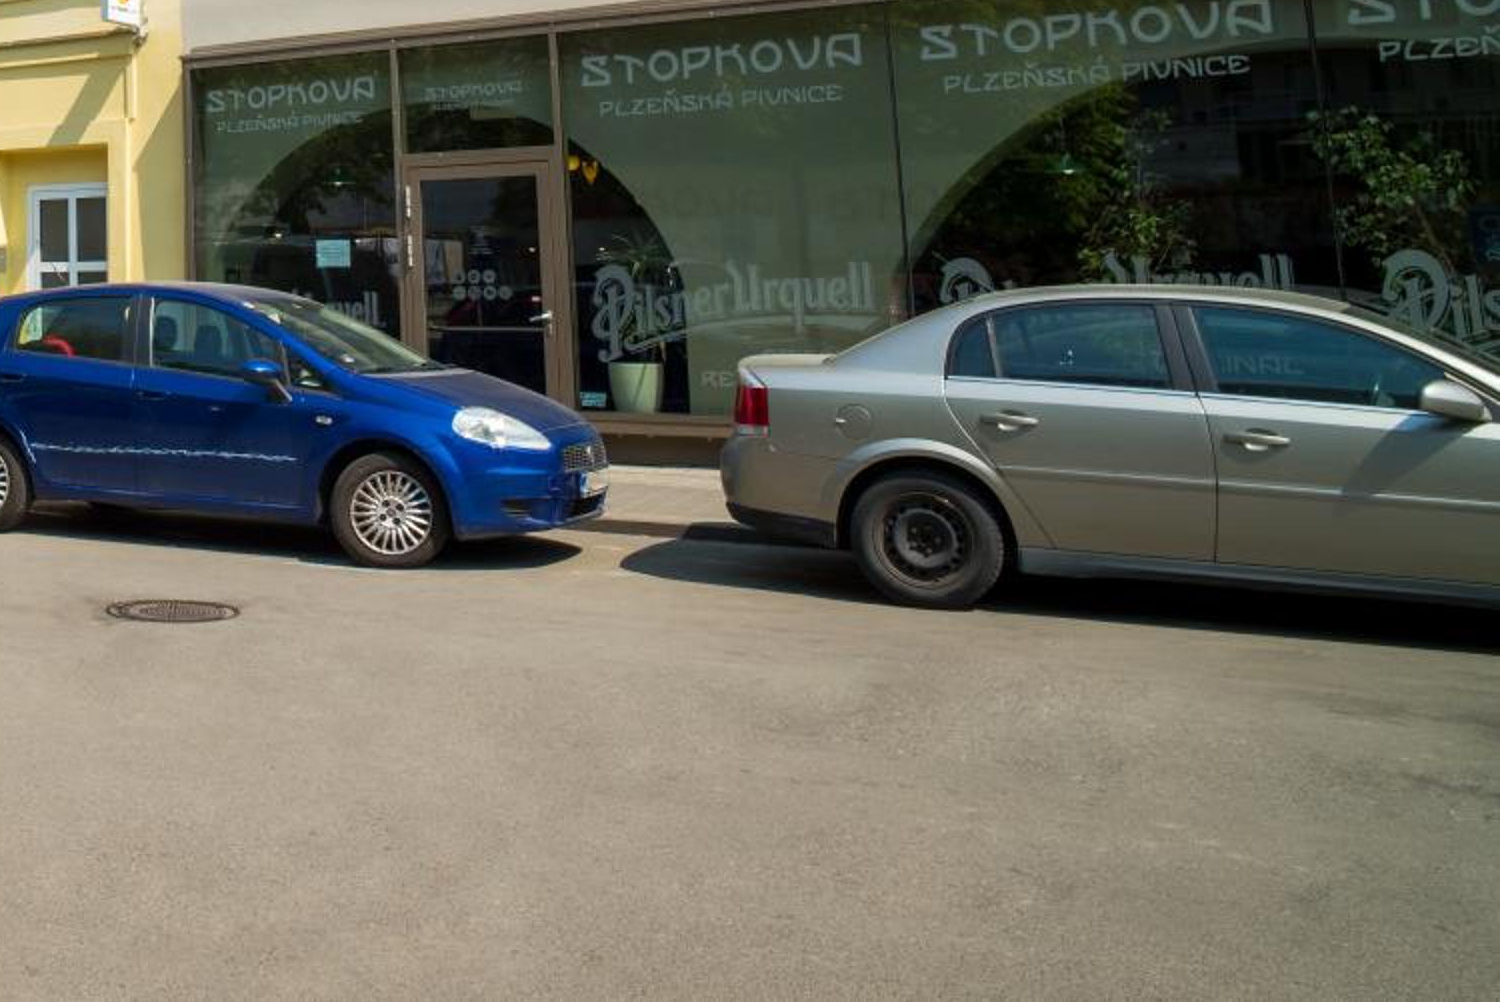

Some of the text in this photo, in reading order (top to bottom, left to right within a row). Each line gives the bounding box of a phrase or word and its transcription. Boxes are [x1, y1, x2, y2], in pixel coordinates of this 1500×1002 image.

[580, 33, 862, 86] STOPKOVA
[943, 54, 1251, 94] PLZEŇSKÁ PIVNICE
[206, 75, 376, 113] STOPKOVA
[599, 84, 845, 118] PLZEŇSKÁ PIVNICE
[592, 264, 730, 363] Pilsner
[725, 256, 876, 335] Urquell
